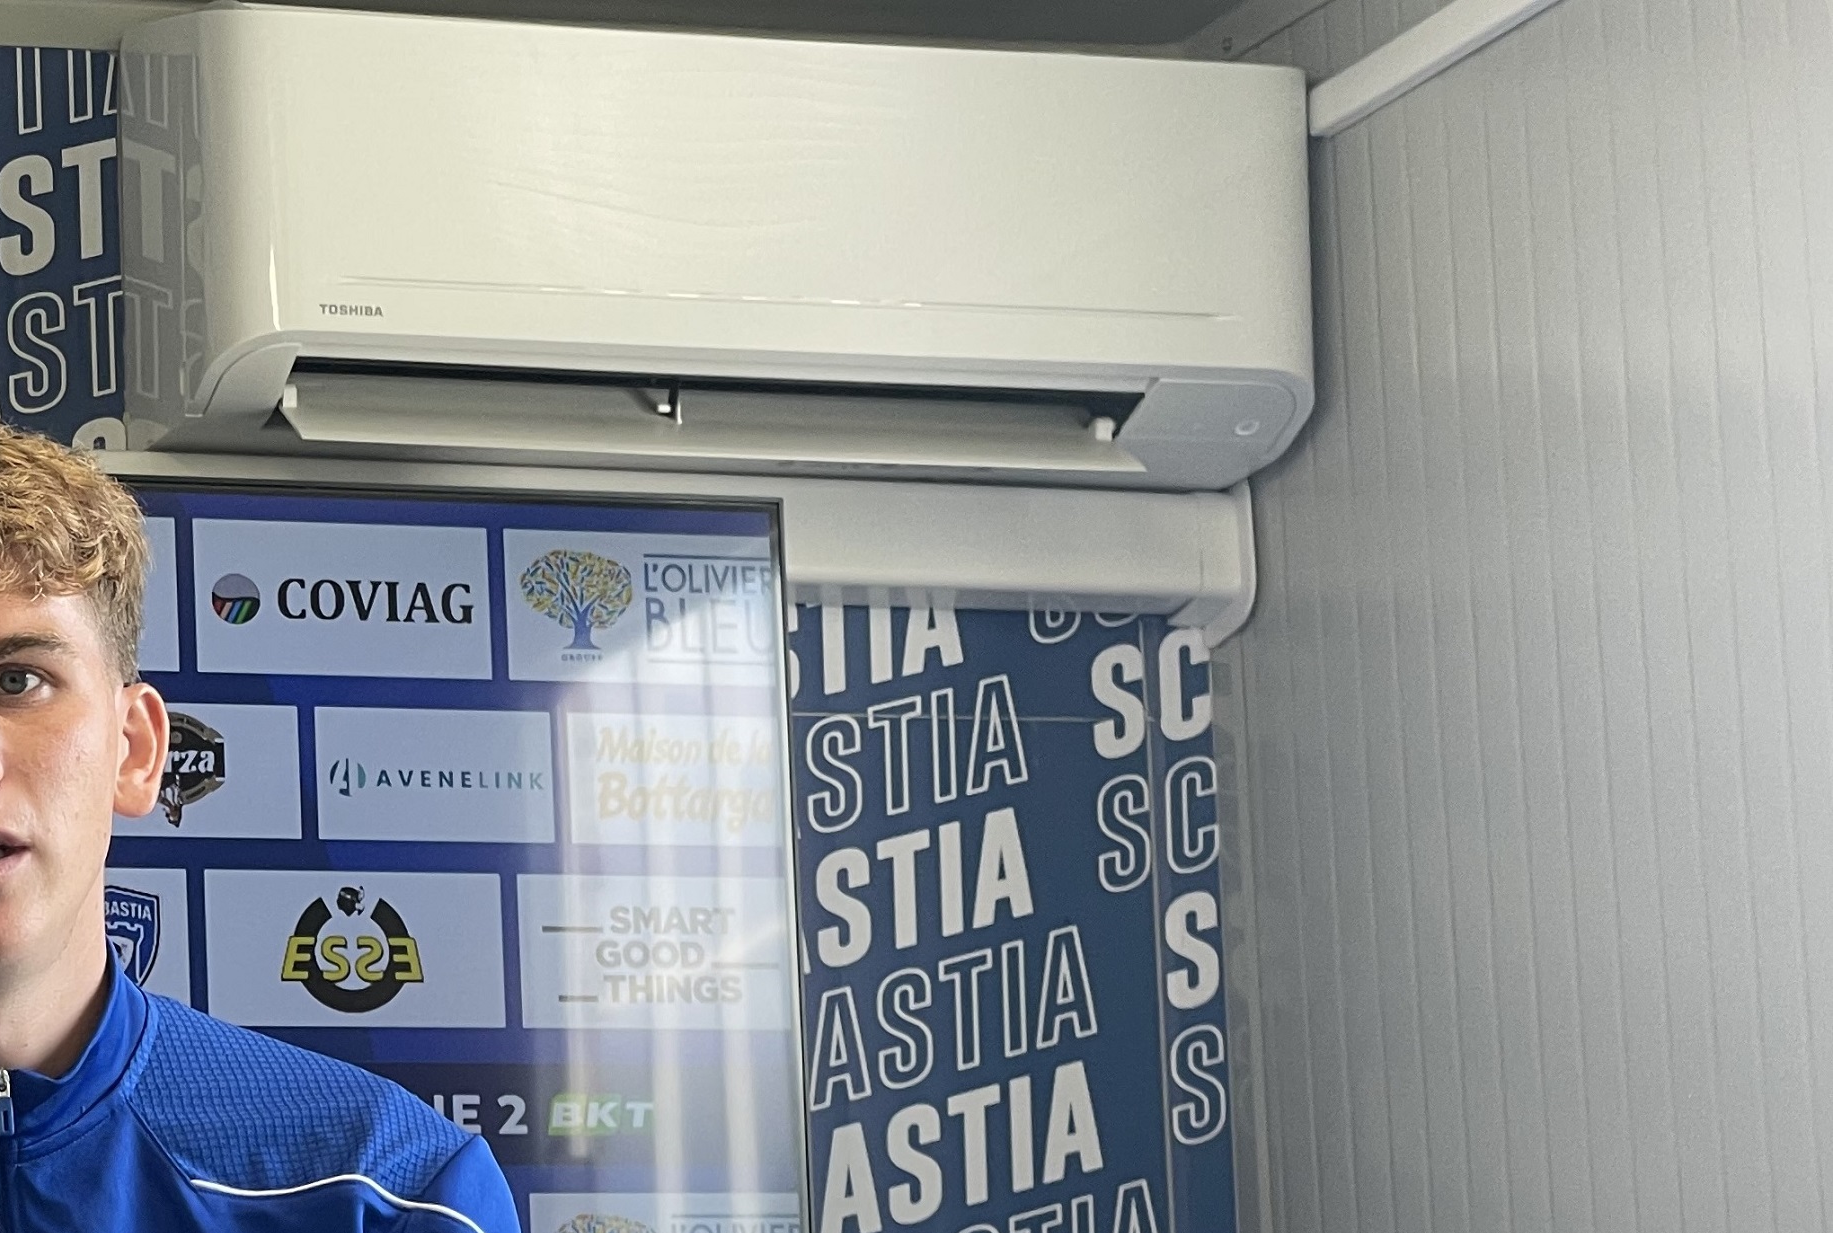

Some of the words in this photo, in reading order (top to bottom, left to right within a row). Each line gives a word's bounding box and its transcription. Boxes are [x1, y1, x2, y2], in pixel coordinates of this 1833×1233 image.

[319, 303, 385, 319] TOSHIBA
[276, 577, 475, 626] COVIAG
[805, 673, 1029, 834] STIA
[1090, 626, 1212, 760] SC
[165, 744, 216, 774] rza
[375, 768, 546, 791] AVENELINK
[815, 807, 1035, 969] STIA
[1096, 755, 1220, 894] SC
[609, 906, 736, 935] SMART
[595, 941, 706, 970] GOOD
[602, 975, 744, 1005] THINGS
[810, 924, 1098, 1112] ASTIA
[1164, 890, 1220, 1010] S
[1169, 1023, 1227, 1145] S
[497, 1094, 529, 1136] 2
[549, 1100, 655, 1130] BKT
